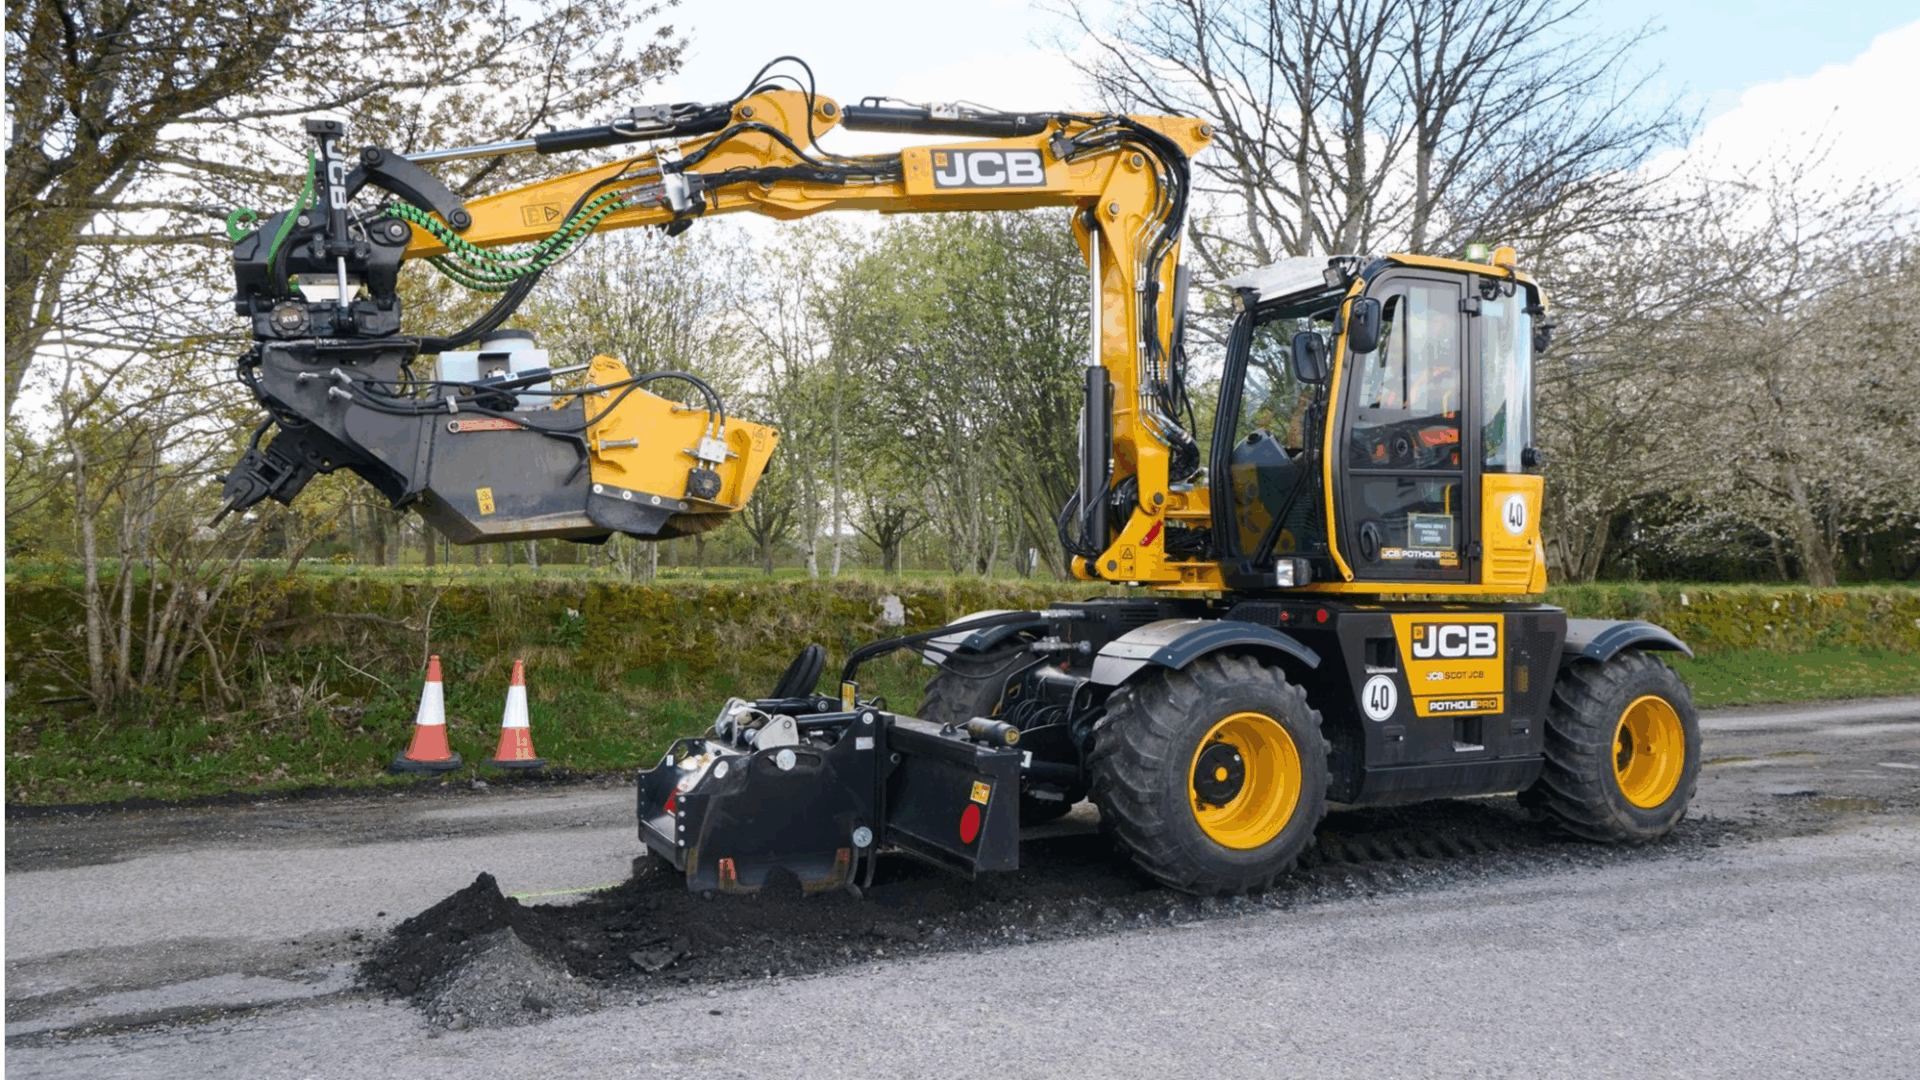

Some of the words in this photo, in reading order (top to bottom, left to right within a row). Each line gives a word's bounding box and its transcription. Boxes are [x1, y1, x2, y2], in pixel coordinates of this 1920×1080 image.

[326, 139, 347, 210] JCB
[935, 151, 1044, 186] JCB
[1509, 502, 1523, 527] 40
[1413, 624, 1497, 658] JCB
[1371, 685, 1389, 711] 40
